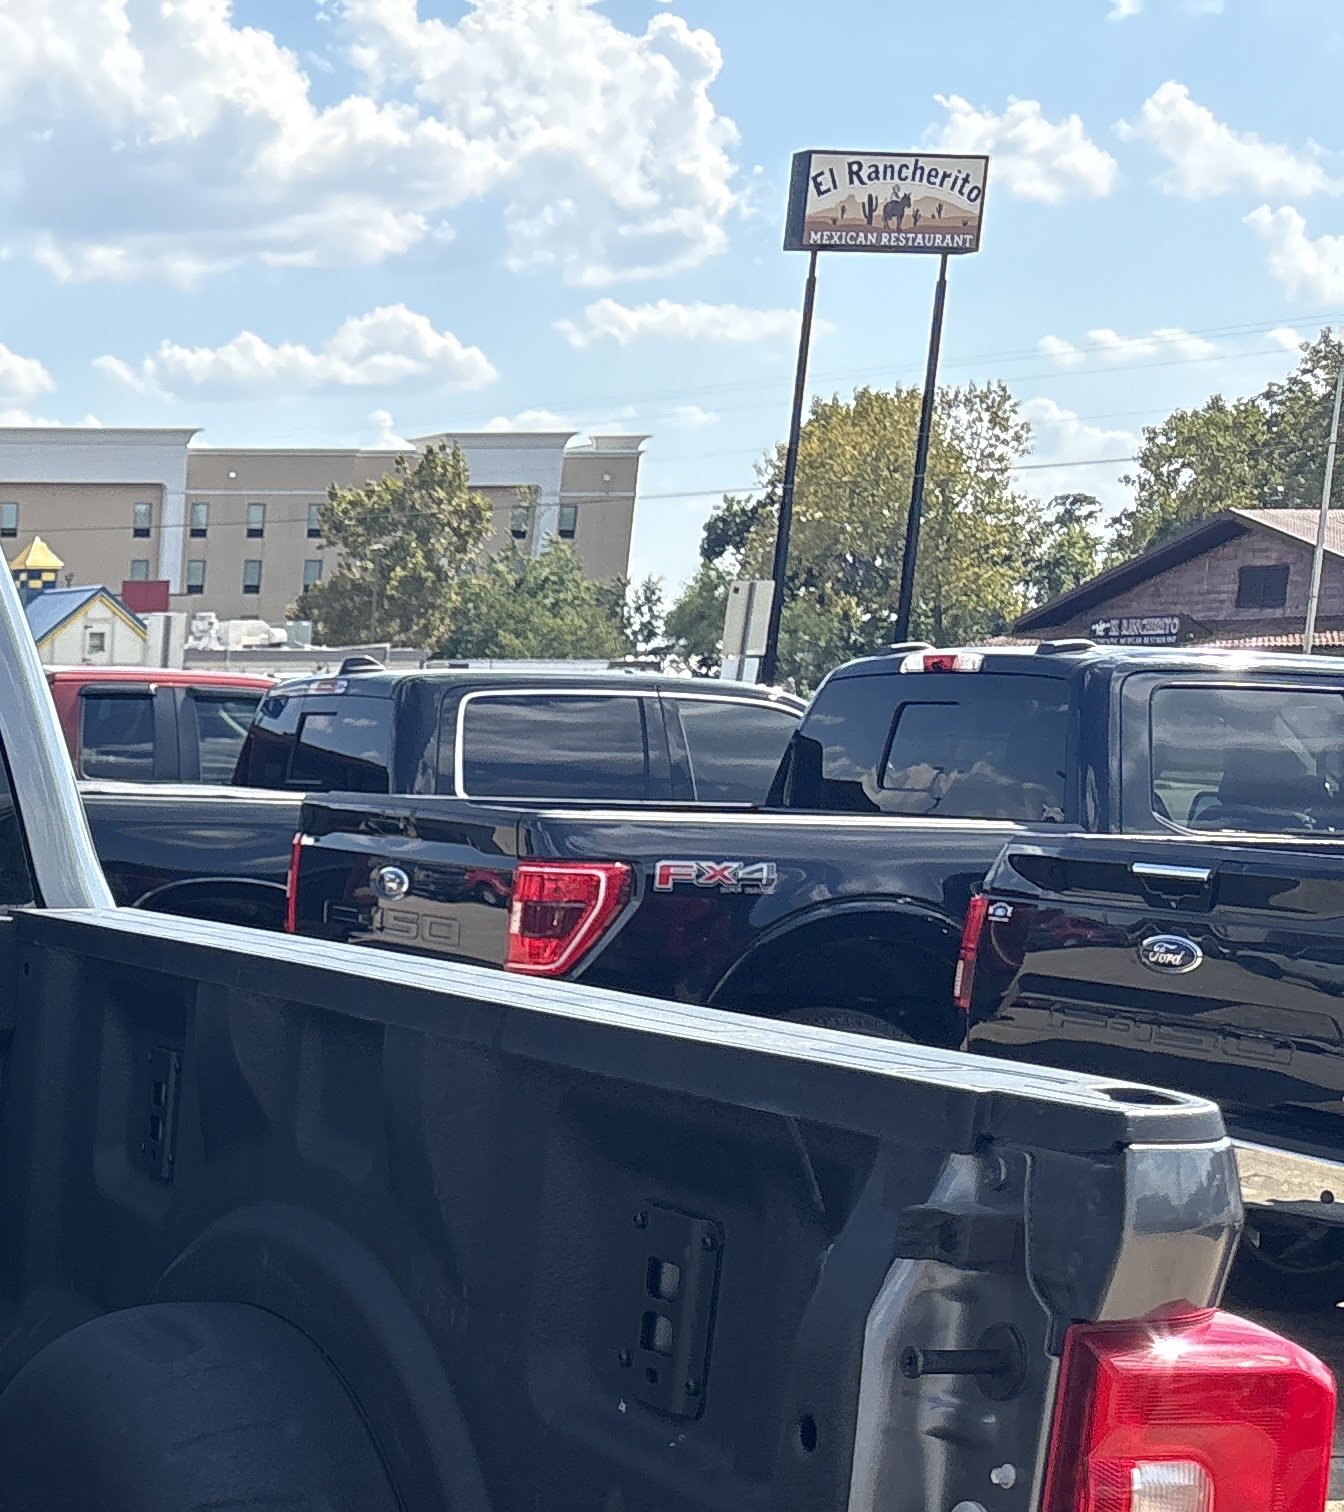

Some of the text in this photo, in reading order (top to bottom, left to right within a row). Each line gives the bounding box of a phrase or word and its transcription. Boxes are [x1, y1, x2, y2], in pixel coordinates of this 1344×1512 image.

[811, 158, 983, 204] El Rancherito
[808, 231, 974, 248] MEXICAN RESTAURANT
[653, 860, 778, 893] FX4
[1147, 941, 1186, 966] Ford
